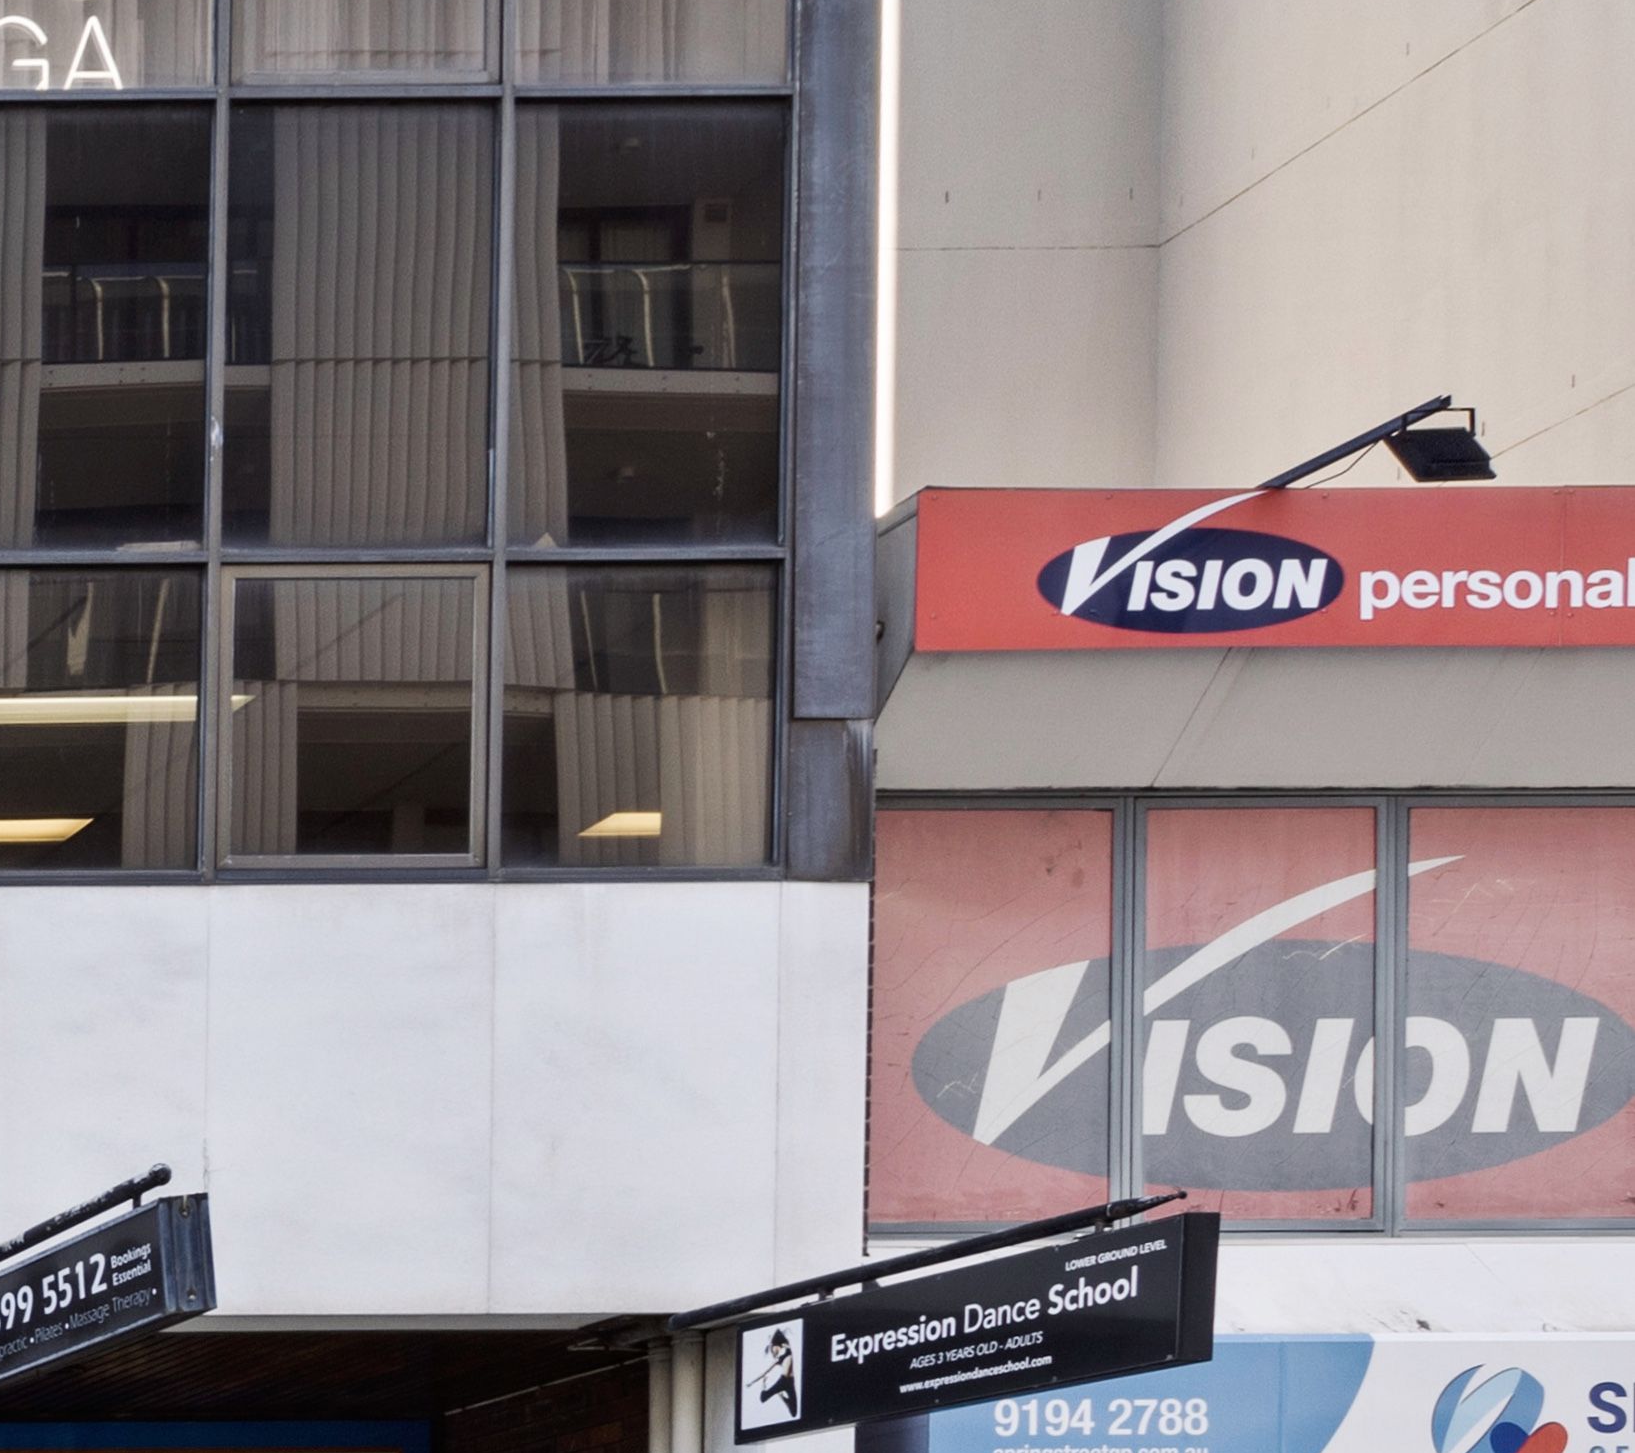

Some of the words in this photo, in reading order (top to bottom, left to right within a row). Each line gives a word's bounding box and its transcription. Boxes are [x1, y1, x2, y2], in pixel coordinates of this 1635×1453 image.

[1058, 489, 1328, 616] VISION
[1359, 560, 1635, 621] personal
[971, 855, 1600, 1147] VISION
[109, 1242, 152, 1270] Bookings
[111, 1259, 152, 1287] Essential
[1064, 1254, 1096, 1272] LOWER
[1096, 1246, 1138, 1266] GROUND
[1139, 1239, 1168, 1254] LEVEL
[41, 1252, 108, 1316] 5512
[69, 1302, 111, 1330] Massage
[111, 1286, 151, 1316] Therapy
[829, 1314, 956, 1365] Expression
[962, 1297, 1041, 1335] Dance
[1047, 1264, 1139, 1316] School
[909, 1354, 936, 1371] AGES
[936, 1351, 944, 1364] 3
[944, 1346, 975, 1364] YEARS
[975, 1342, 998, 1357] OLD
[1003, 1331, 1044, 1352] ADULTS
[898, 1354, 1053, 1394] www.expressiondanceschool.com
[993, 1398, 1096, 1439] 9194
[1106, 1398, 1210, 1438] 2788
